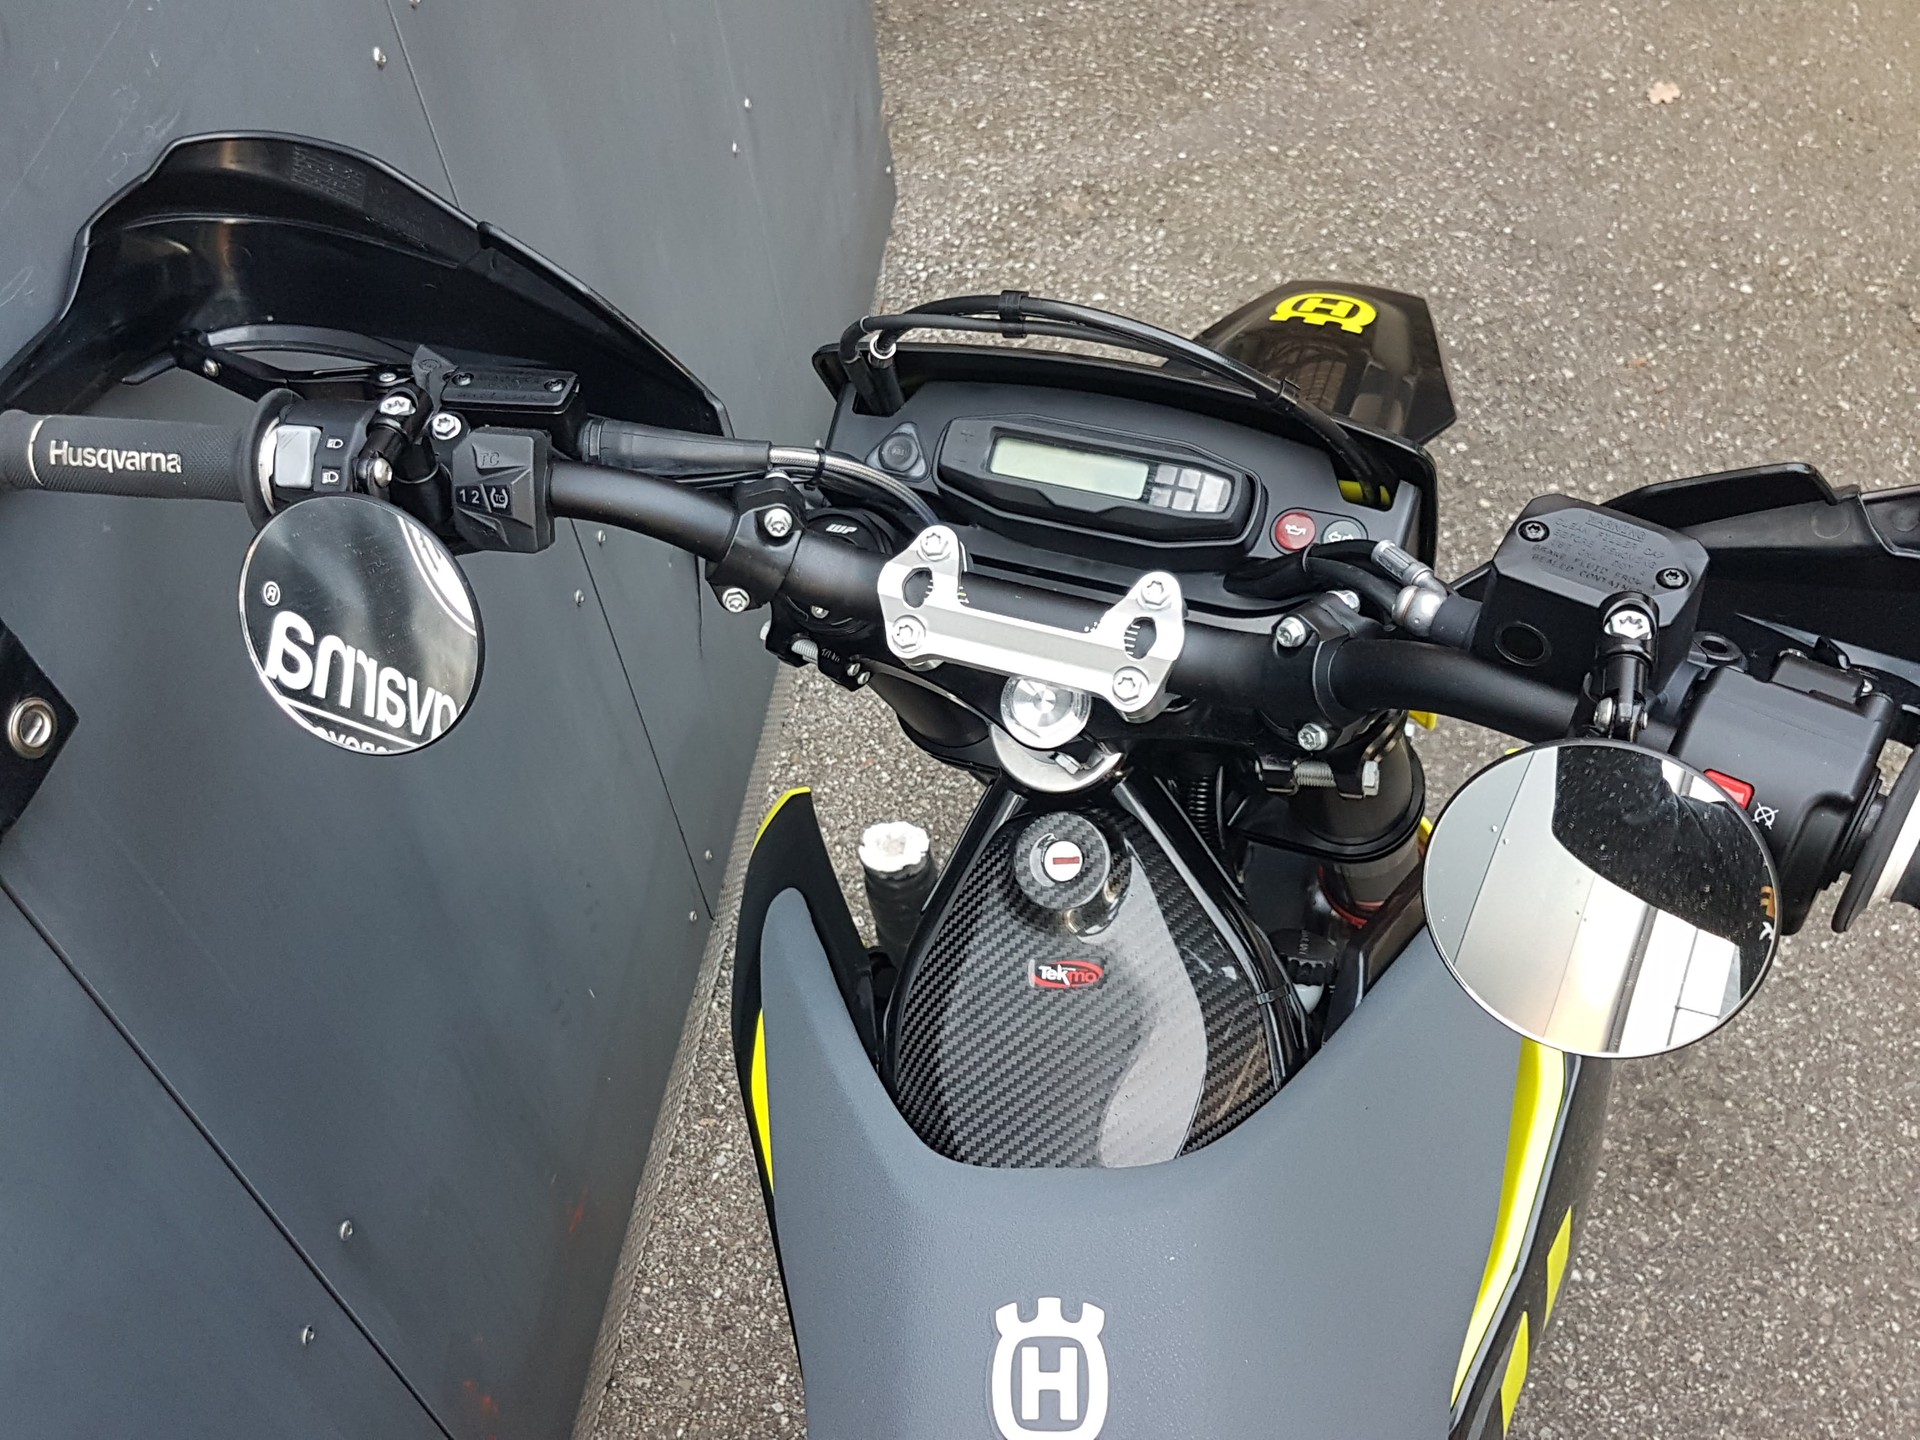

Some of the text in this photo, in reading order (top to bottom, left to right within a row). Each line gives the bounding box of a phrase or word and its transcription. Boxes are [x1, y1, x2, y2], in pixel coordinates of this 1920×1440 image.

[50, 440, 182, 474] Husqvarna
[480, 452, 500, 466] TC
[459, 489, 480, 504] 1 2
[1038, 963, 1098, 987] Tekmo
